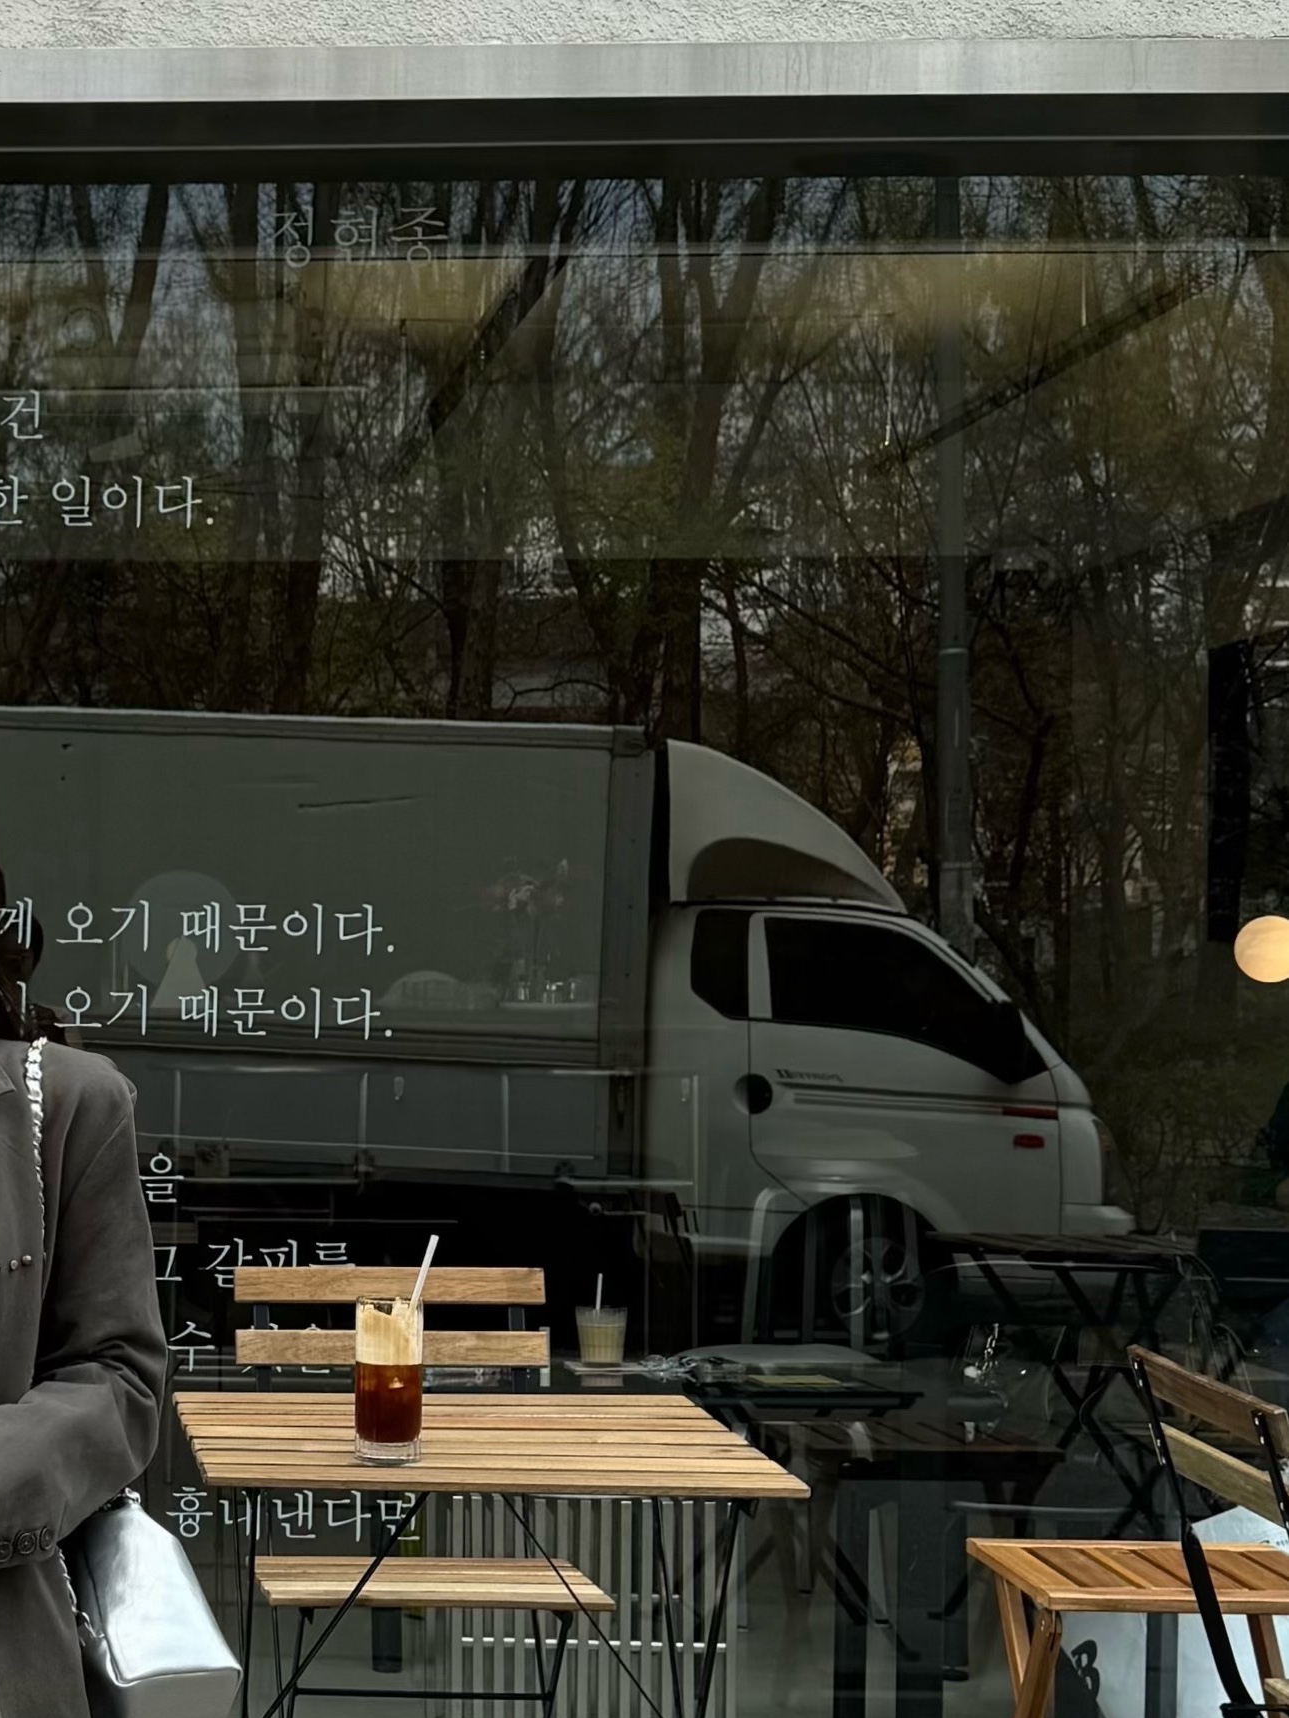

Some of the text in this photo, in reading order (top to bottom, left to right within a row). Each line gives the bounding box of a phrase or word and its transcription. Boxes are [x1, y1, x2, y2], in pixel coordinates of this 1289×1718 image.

[271, 204, 449, 269] 정현종
[0, 388, 44, 440] 건
[52, 475, 215, 529] 일이다.
[55, 901, 150, 953] 오기
[180, 901, 395, 956] 때문이다.
[54, 984, 148, 1036] 오기
[178, 985, 393, 1040] 때문이다.
[139, 1152, 185, 1203] 을
[166, 1321, 216, 1372] 수
[166, 1486, 420, 1542] 흉내낸다면
